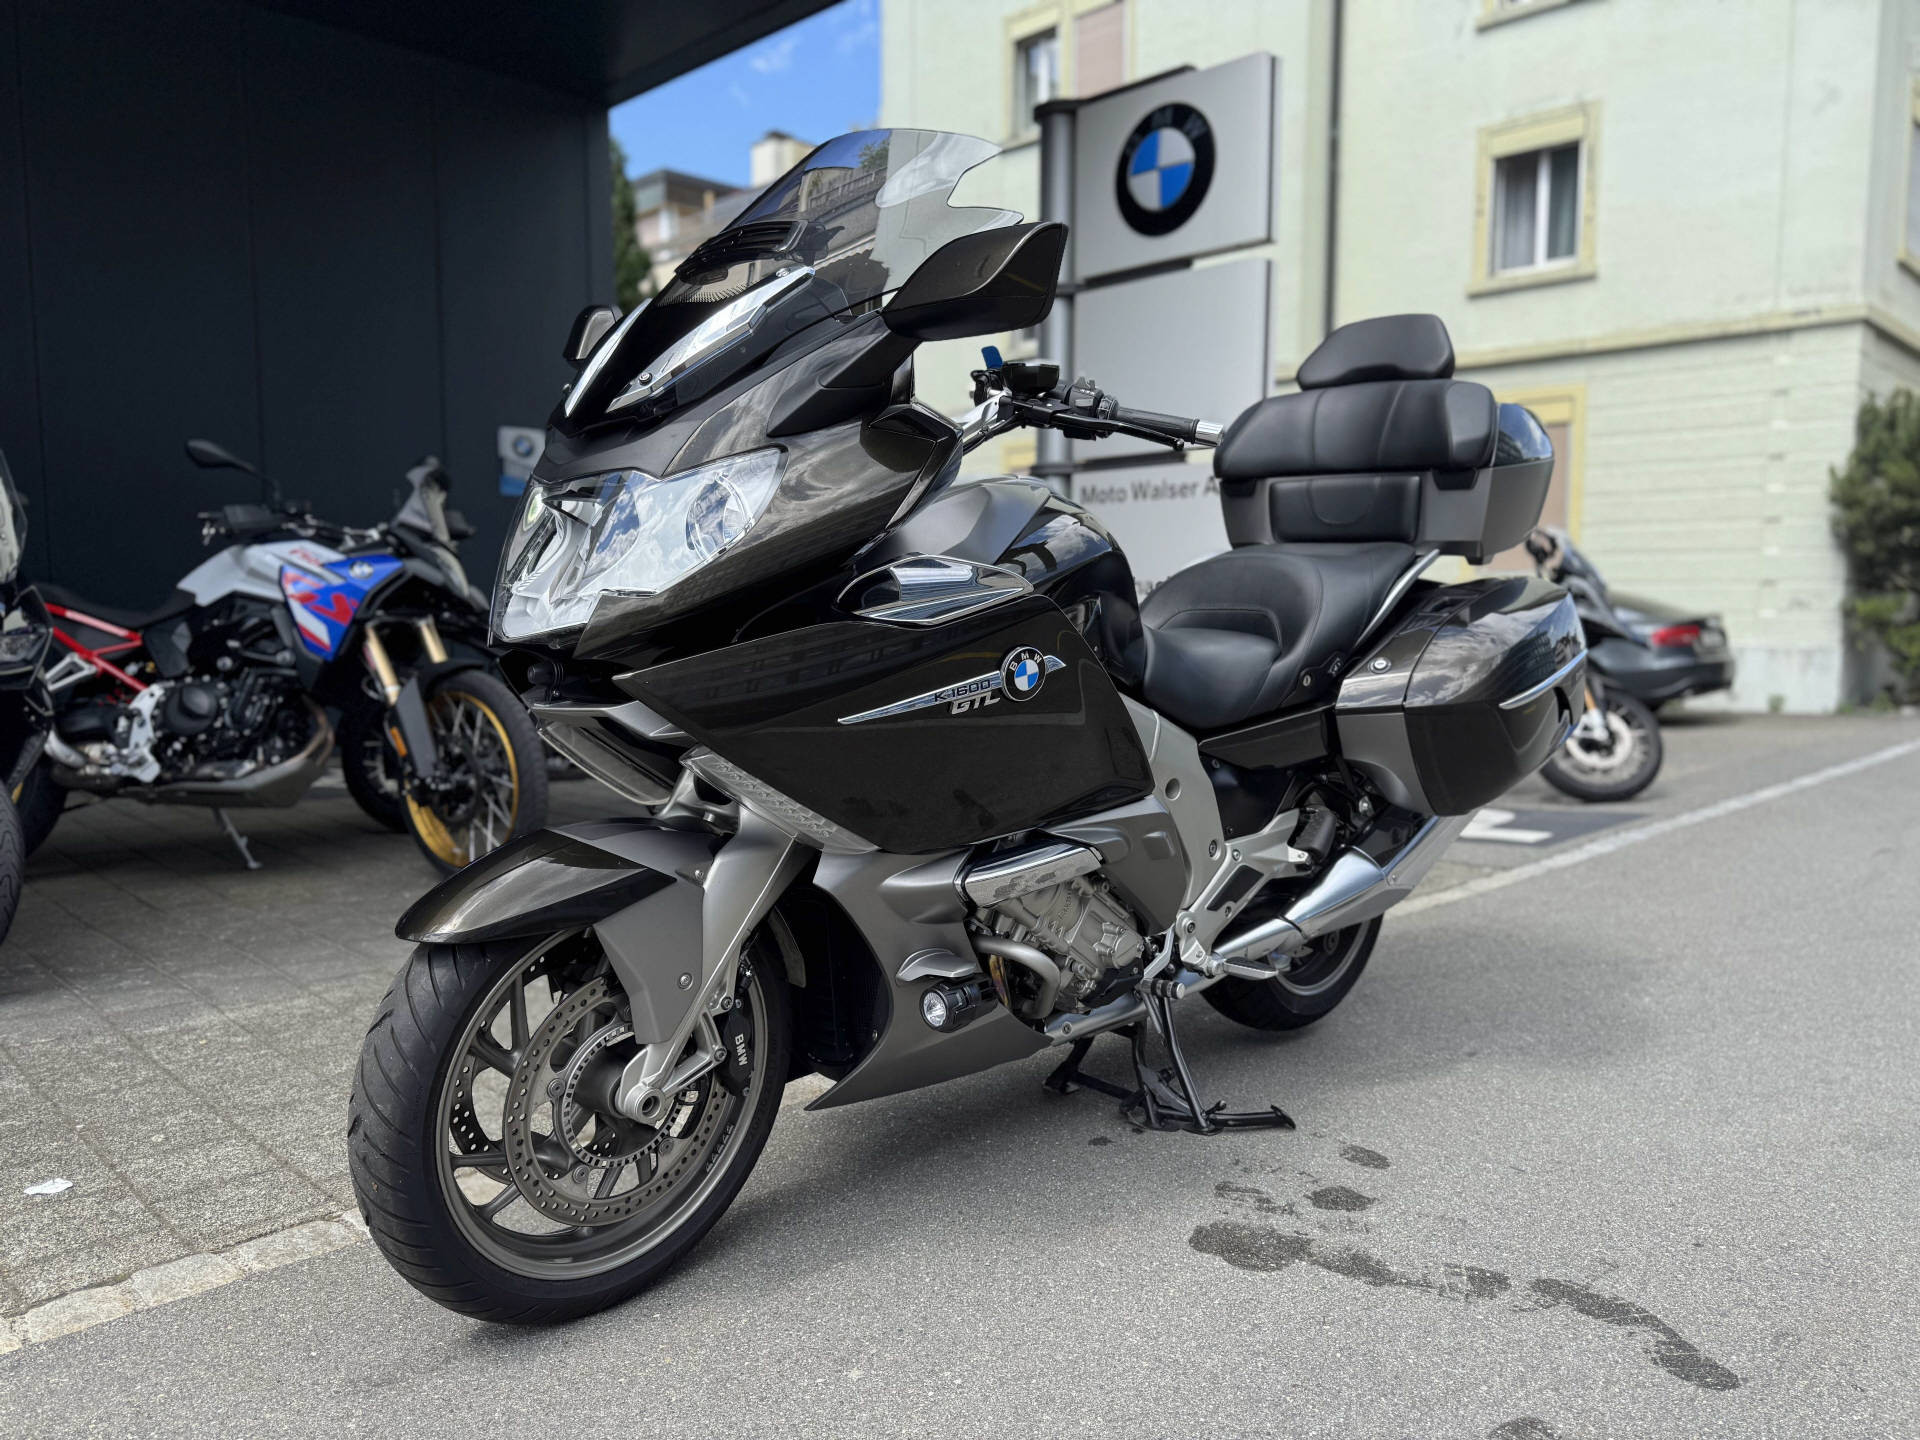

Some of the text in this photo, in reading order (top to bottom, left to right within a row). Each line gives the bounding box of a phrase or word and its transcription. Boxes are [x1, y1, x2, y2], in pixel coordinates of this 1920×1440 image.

[1081, 484, 1127, 504] Moto
[1130, 477, 1198, 501] Walser
[1009, 651, 1042, 672] BMW
[951, 691, 1001, 715] GTL
[734, 1033, 749, 1067] BMW
